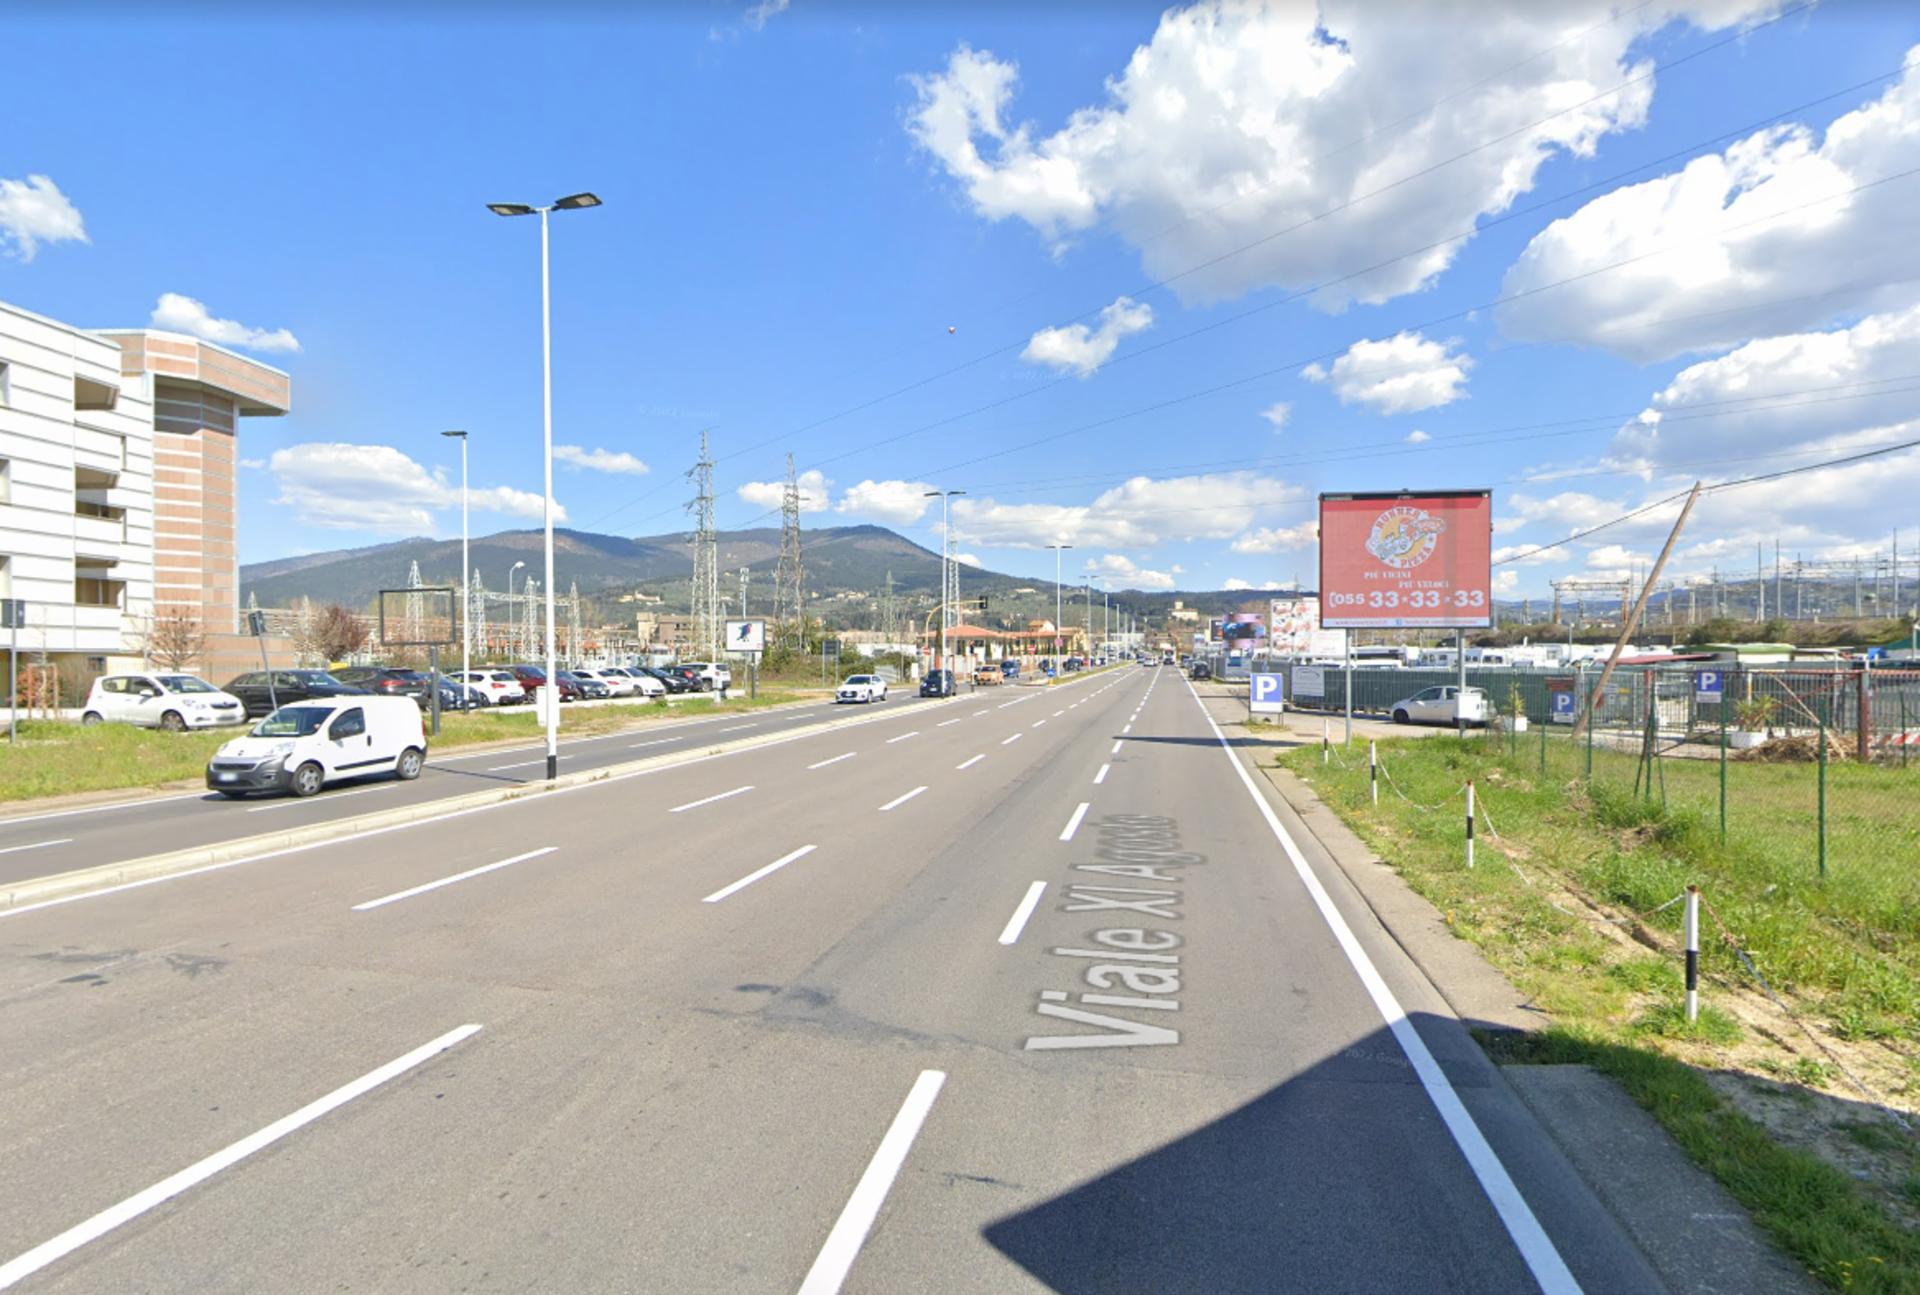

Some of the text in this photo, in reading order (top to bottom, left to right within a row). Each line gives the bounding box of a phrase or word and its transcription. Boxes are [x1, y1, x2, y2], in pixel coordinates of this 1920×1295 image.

[1256, 676, 1277, 700] P
[1701, 672, 1717, 690] P
[1557, 694, 1570, 711] P
